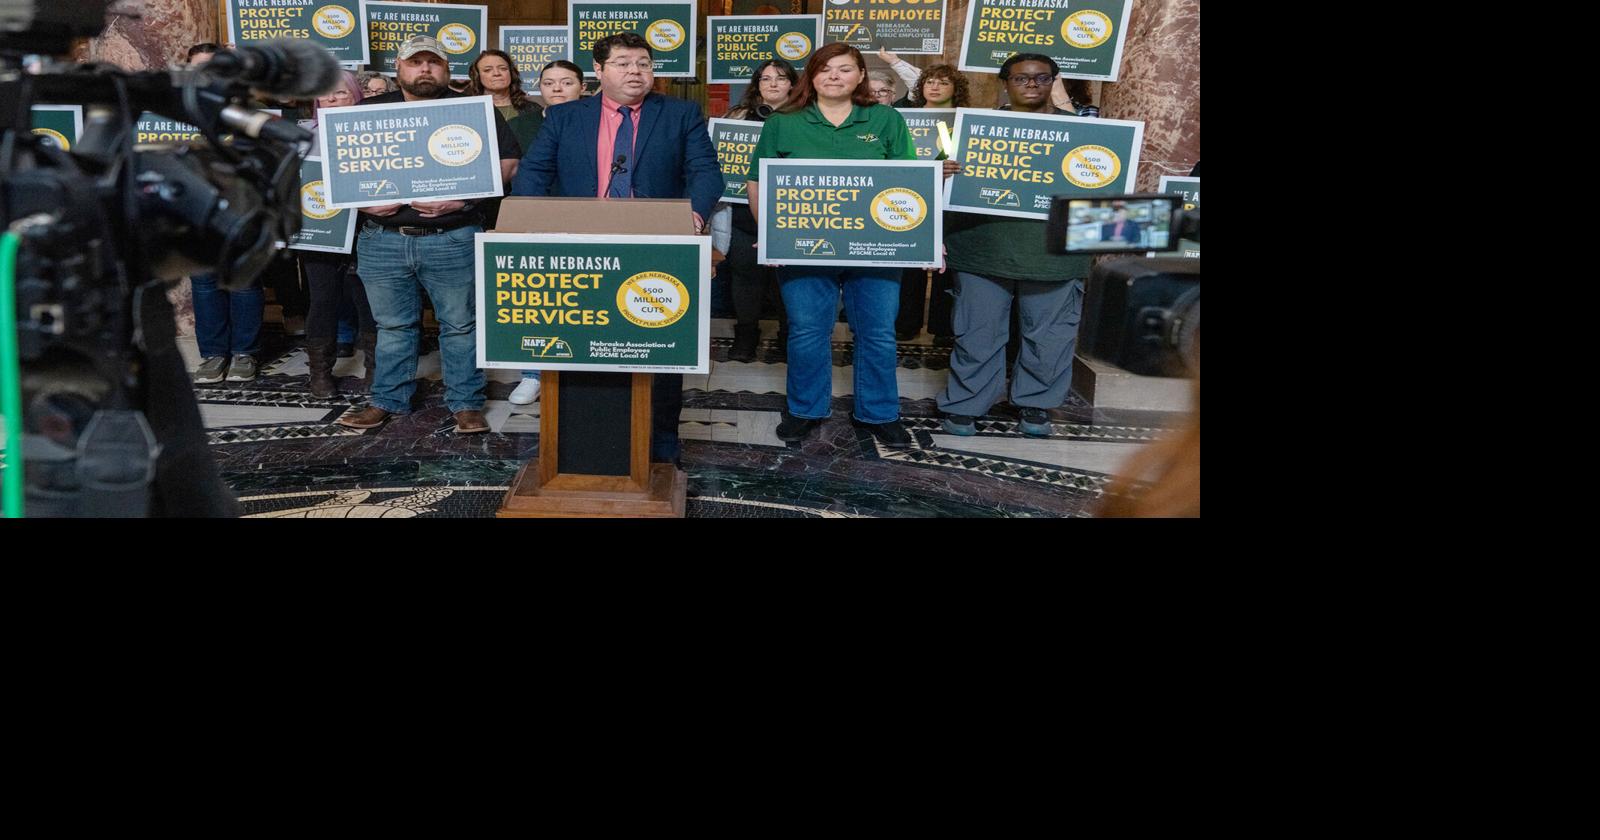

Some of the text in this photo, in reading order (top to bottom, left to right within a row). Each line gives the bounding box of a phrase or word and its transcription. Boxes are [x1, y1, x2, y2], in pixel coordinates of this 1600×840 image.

[1020, 0, 1069, 8] NEBRASKA
[240, 8, 304, 18] PROTECT
[371, 12, 440, 22] WE ARE NEBRASKA
[579, 11, 590, 19] WE
[593, 11, 606, 19] ARE
[826, 9, 940, 20] STATE EMPLOYEE
[981, 7, 1055, 20] PROTECT
[240, 19, 290, 29] PUBLIC
[371, 22, 430, 32] PROTECT
[580, 21, 638, 30] PROTECT
[979, 19, 1036, 32] PUBLIC
[242, 29, 310, 40] SERVICES
[717, 34, 770, 42] PROTECT
[977, 32, 1055, 45] SERVICES
[510, 45, 564, 53] PROTECT
[717, 52, 772, 60] SERVICES
[137, 121, 172, 131] WE ARE
[335, 116, 429, 132] WE ARE NEBRASKA
[138, 132, 202, 143] PROTEC
[336, 130, 416, 146] PROTECT
[720, 131, 731, 140] WE
[734, 132, 750, 142] ARE
[970, 124, 1070, 143] WE ARE NEBRASKA
[337, 144, 400, 160] PUBLIC
[718, 142, 756, 153] PROT
[968, 137, 1055, 155] PROTECT
[339, 156, 424, 173] SERVICES
[717, 152, 751, 164] PUBL
[965, 152, 1032, 168] PUBLIC
[776, 175, 874, 187] WE ARE NEBRASKA
[964, 165, 1055, 184] SERVICES
[776, 188, 860, 202] PROTECT
[776, 202, 840, 215] PUBLIC
[776, 217, 865, 230] SERVICES
[496, 256, 620, 270] WE ARE NEBRASKA
[496, 273, 603, 289] PROTECT
[649, 273, 680, 287] NEBRASKA
[496, 290, 578, 306] PUBLIC
[496, 309, 609, 325] SERVICES
